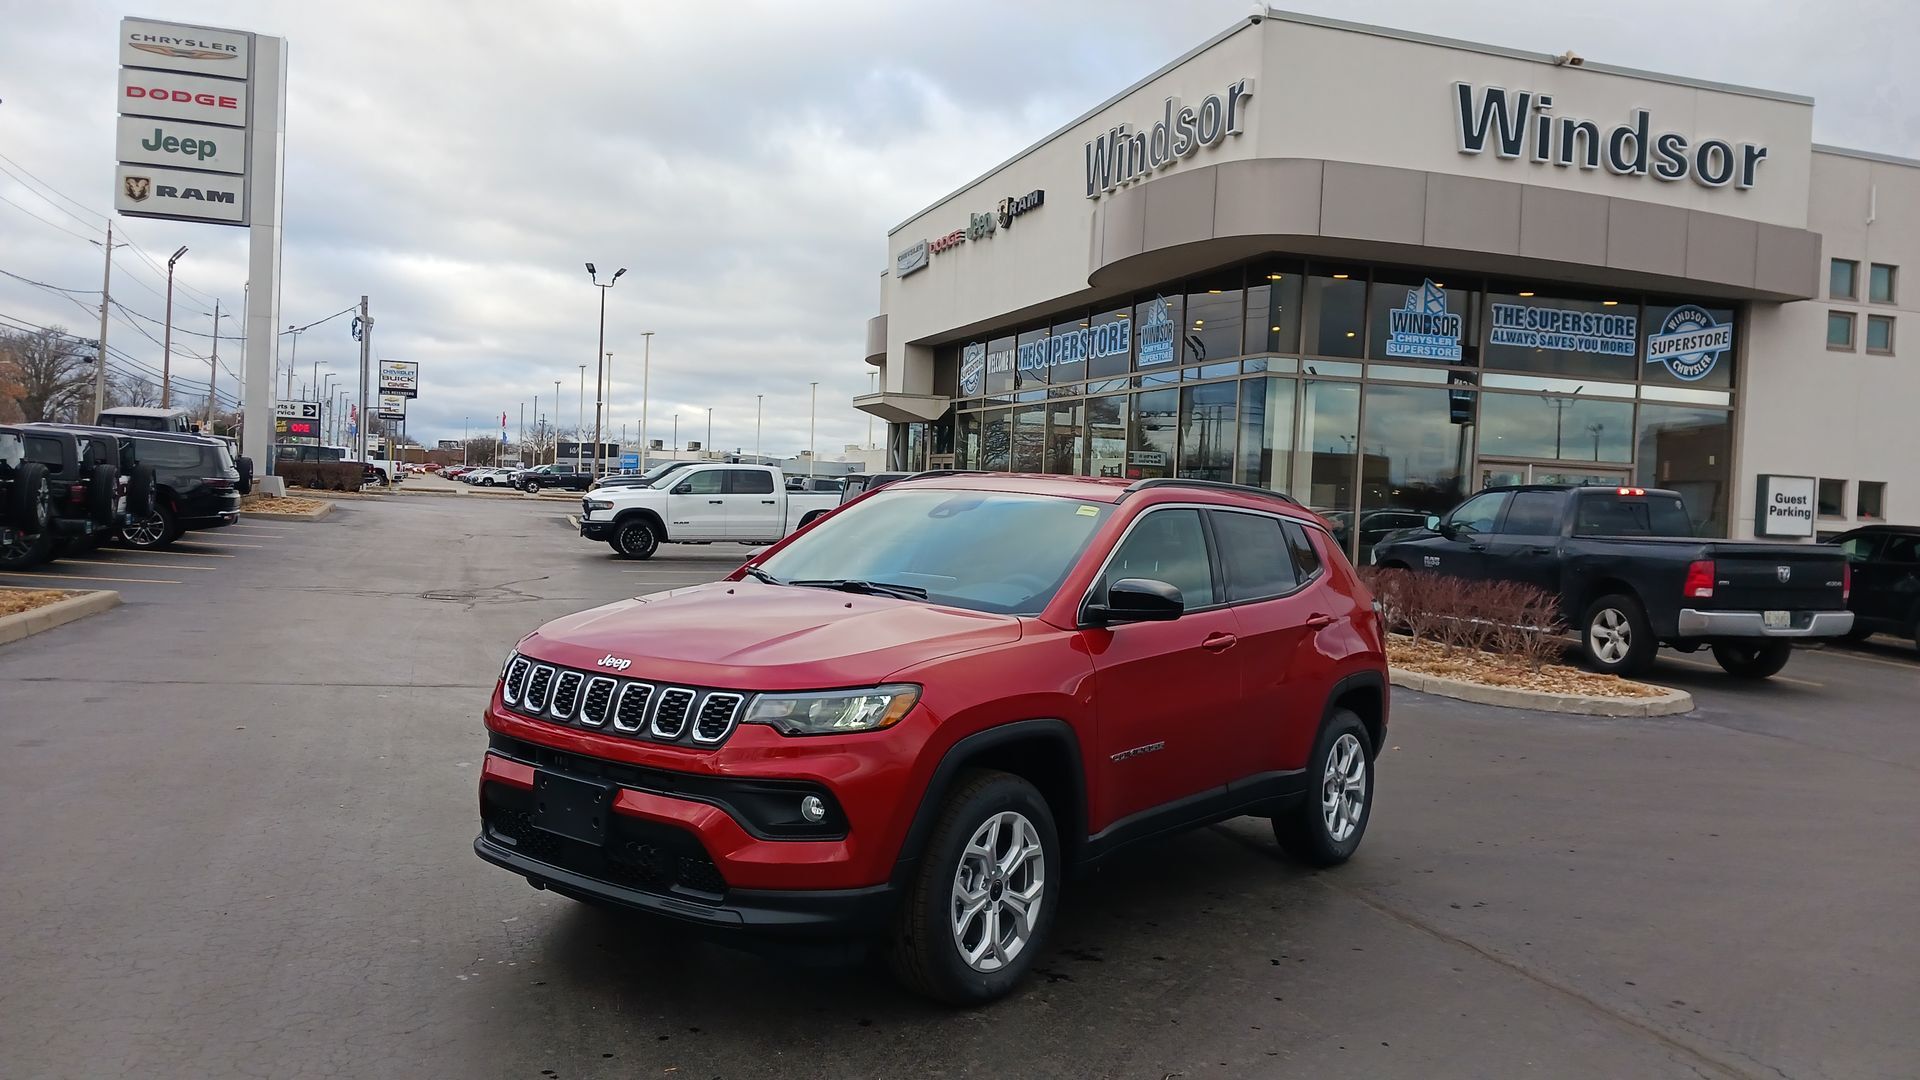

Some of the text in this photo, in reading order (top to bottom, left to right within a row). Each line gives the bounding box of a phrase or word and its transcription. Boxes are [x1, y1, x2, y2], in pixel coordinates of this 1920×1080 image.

[129, 32, 237, 53] CHRYSLER
[126, 85, 238, 110] DODGE
[141, 128, 217, 161] Jeep
[1085, 78, 1255, 200] Windsor
[1452, 80, 1768, 189] Windsor
[155, 184, 236, 204] RAM
[1008, 190, 1045, 216] RAM
[929, 229, 966, 254] DODGE
[1392, 311, 1459, 337] WINDSOR
[1493, 305, 1637, 338] THE SUPERSTORE
[1668, 310, 1708, 330] WINDSOR
[1018, 343, 1034, 370] THE
[1035, 319, 1130, 369] SUPERSTORE
[1142, 322, 1173, 346] WINDSOR
[1397, 334, 1452, 346] CHRYSLER
[1491, 330, 1635, 355] ALWAYS SAVES YOU MORE!
[1650, 331, 1729, 356] SUPERSTORE
[1389, 343, 1460, 357] SUPERSTORE
[1672, 354, 1712, 376] CHRYSLER
[381, 375, 415, 383] BUICK
[1775, 493, 1807, 505] Guest
[1769, 505, 1811, 520] Parking
[597, 653, 632, 671] Jeep
